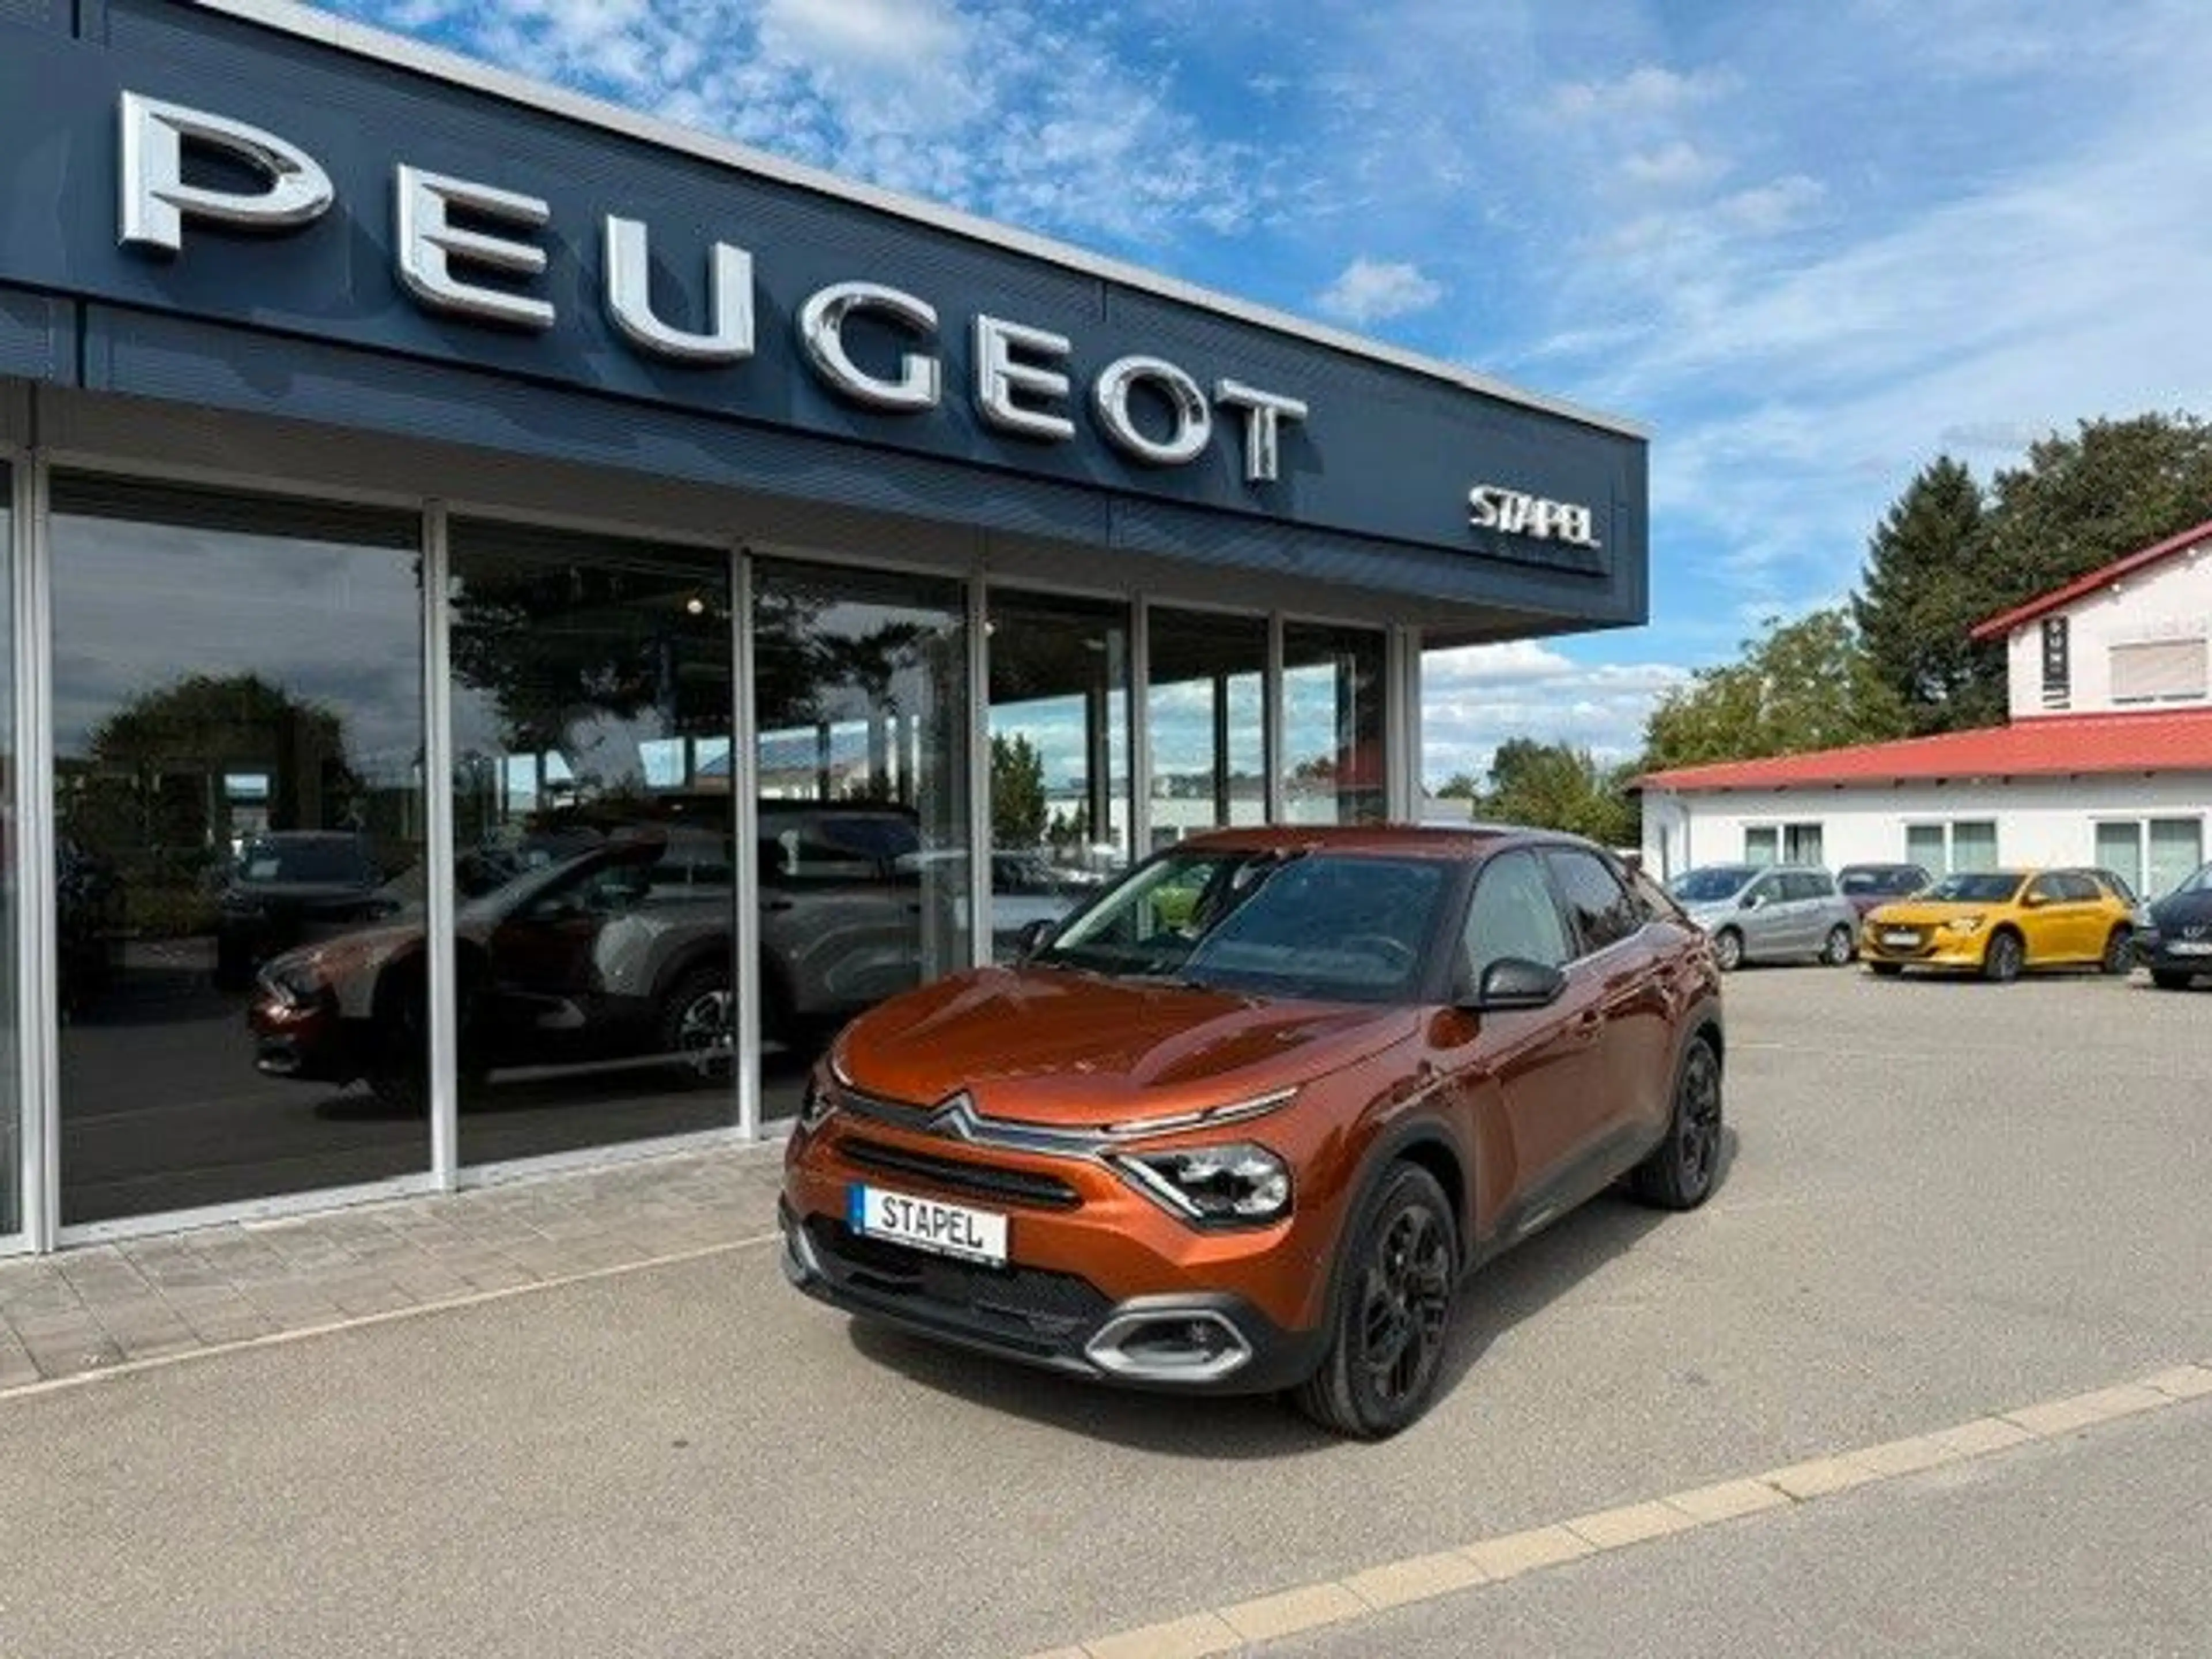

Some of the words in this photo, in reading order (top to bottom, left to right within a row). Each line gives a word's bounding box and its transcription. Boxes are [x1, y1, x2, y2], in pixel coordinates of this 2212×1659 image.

[119, 90, 1309, 483] PEUGEOT
[1469, 485, 1602, 548] STAPEL
[881, 1196, 983, 1248] STAPEL
